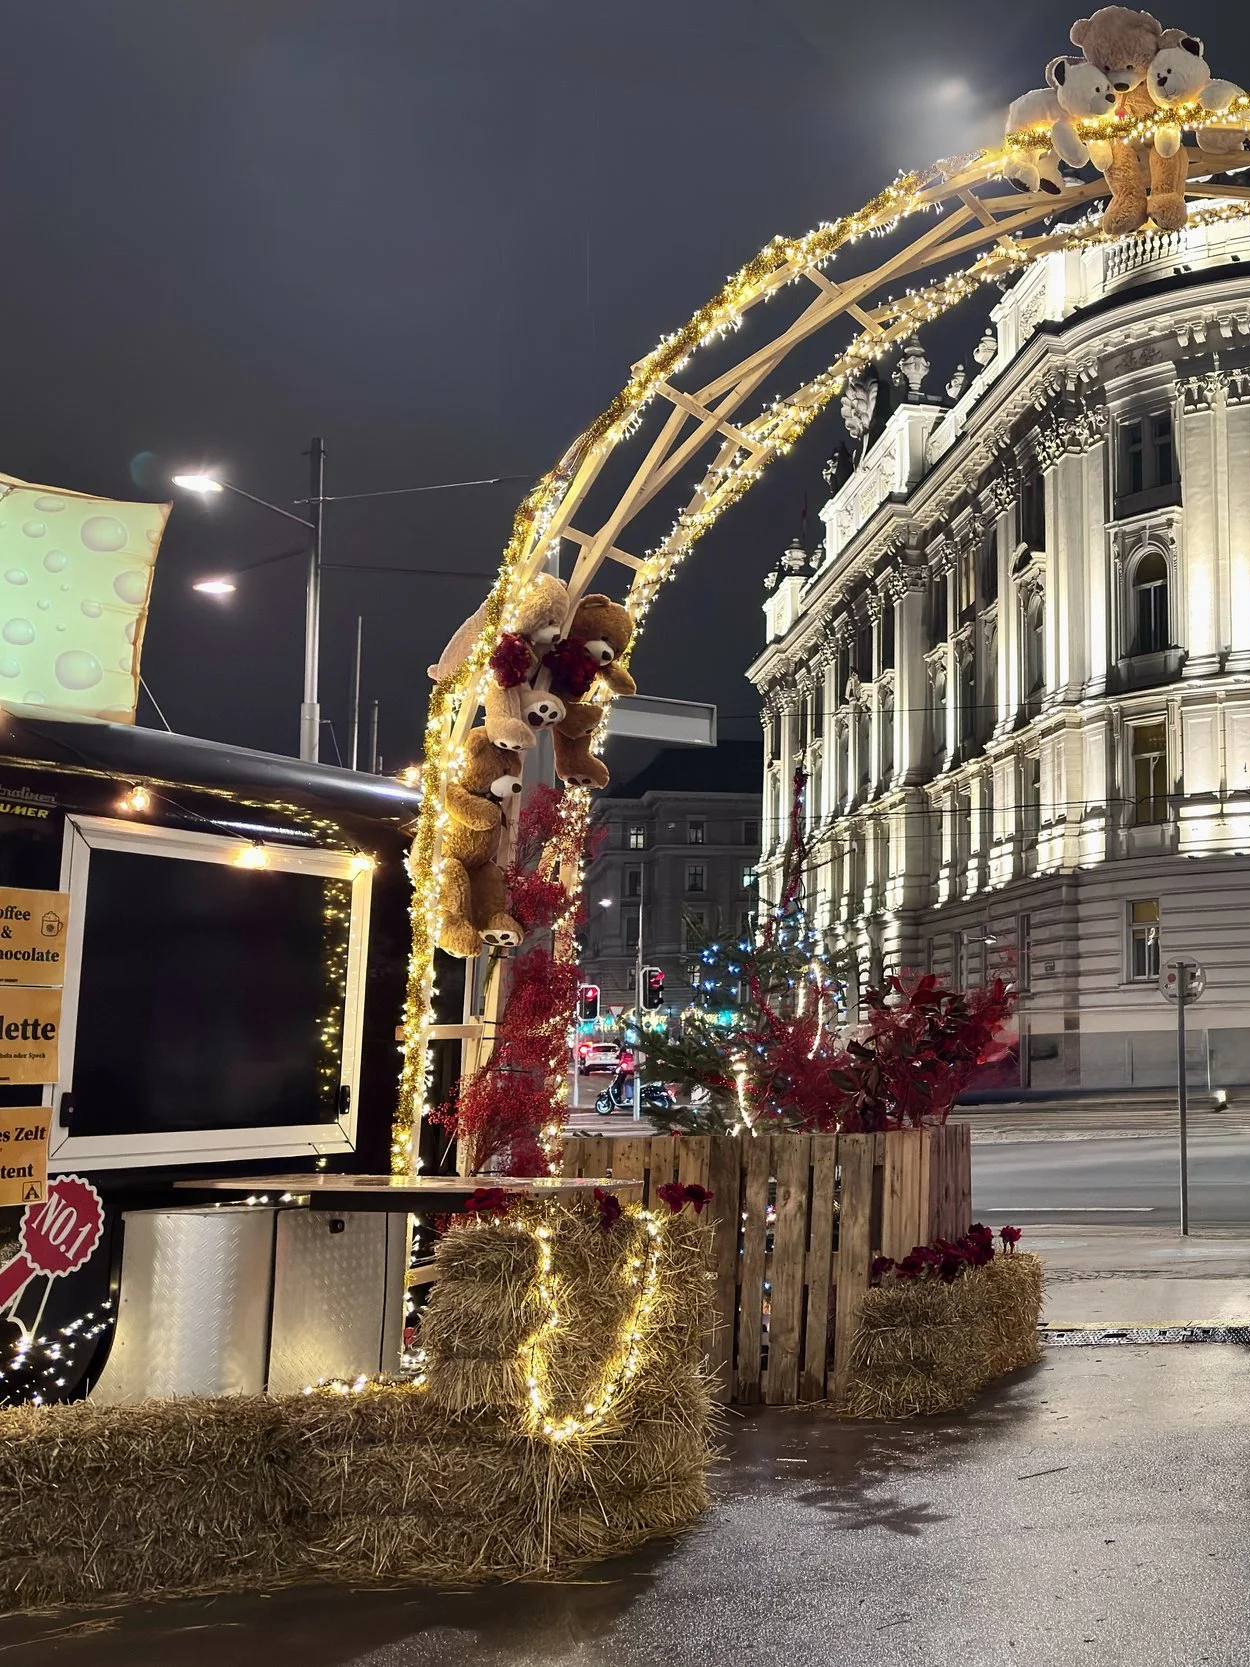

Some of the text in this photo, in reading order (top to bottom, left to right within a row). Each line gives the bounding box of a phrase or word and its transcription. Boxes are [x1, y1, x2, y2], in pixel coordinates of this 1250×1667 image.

[1, 925, 12, 939] &
[14, 1125, 46, 1141] Zelt
[0, 1163, 34, 1179] tent
[31, 1191, 93, 1261] NO.1
